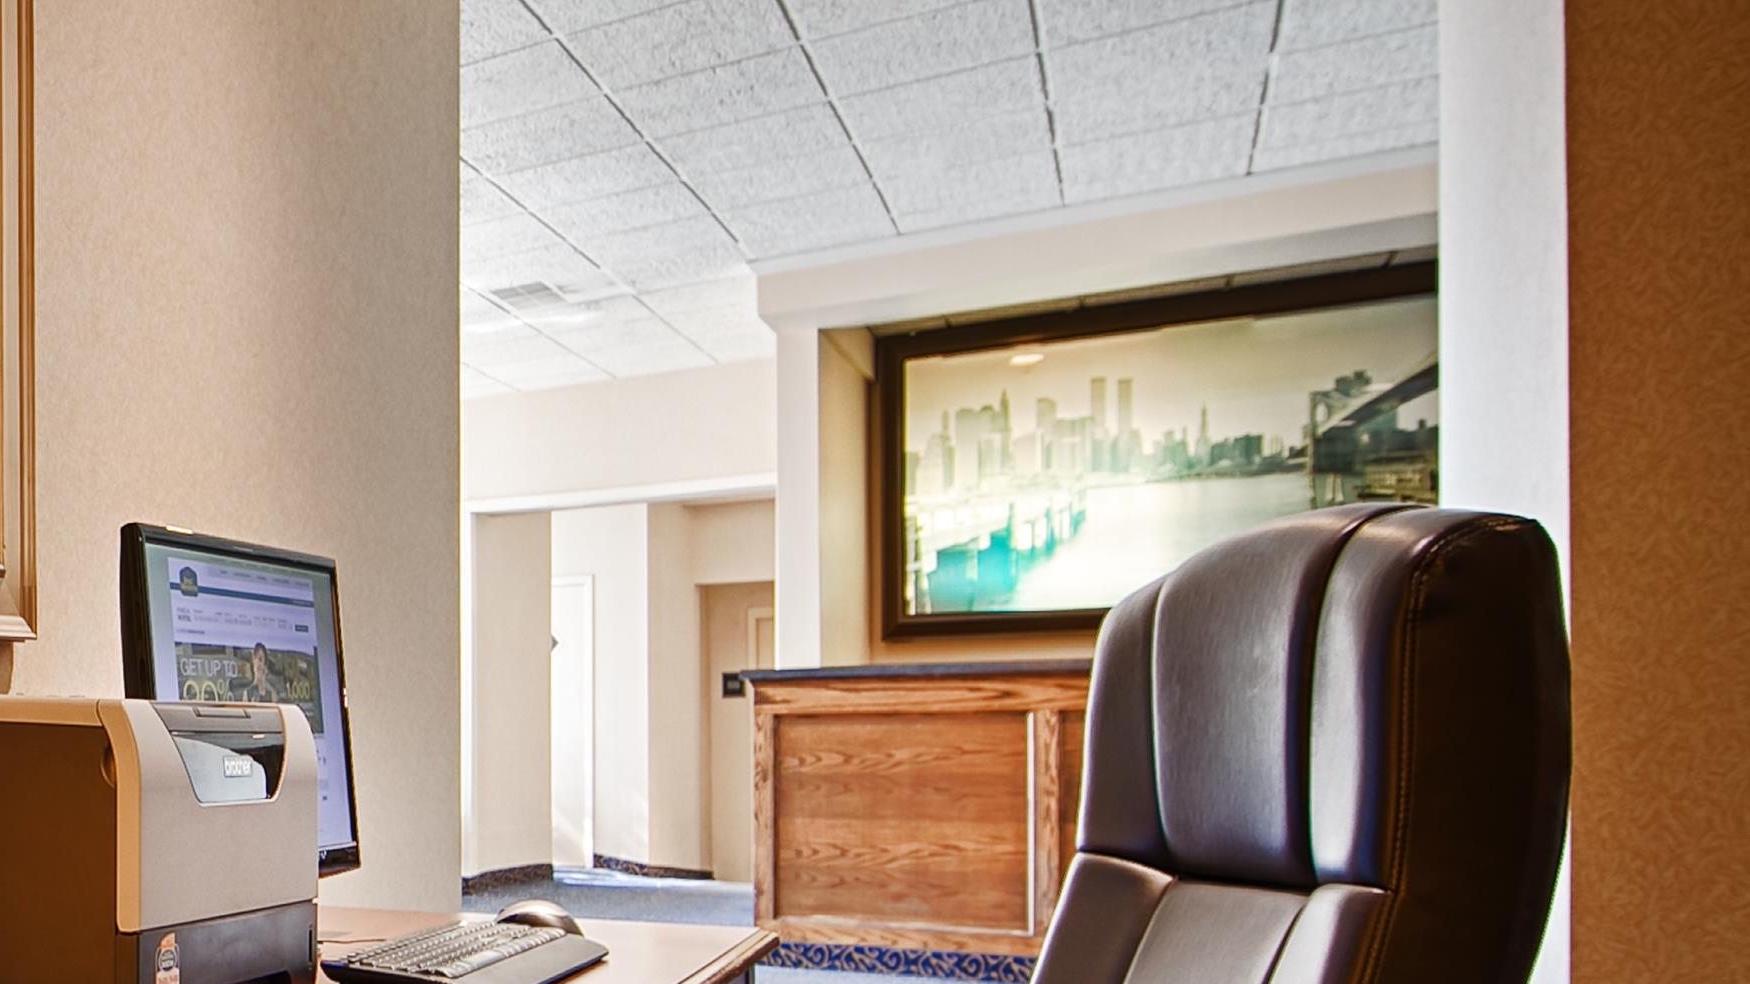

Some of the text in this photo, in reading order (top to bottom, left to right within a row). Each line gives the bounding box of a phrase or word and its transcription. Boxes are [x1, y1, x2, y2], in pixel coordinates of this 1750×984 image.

[180, 658, 238, 678] GET UP TO
[224, 757, 251, 776] brother
